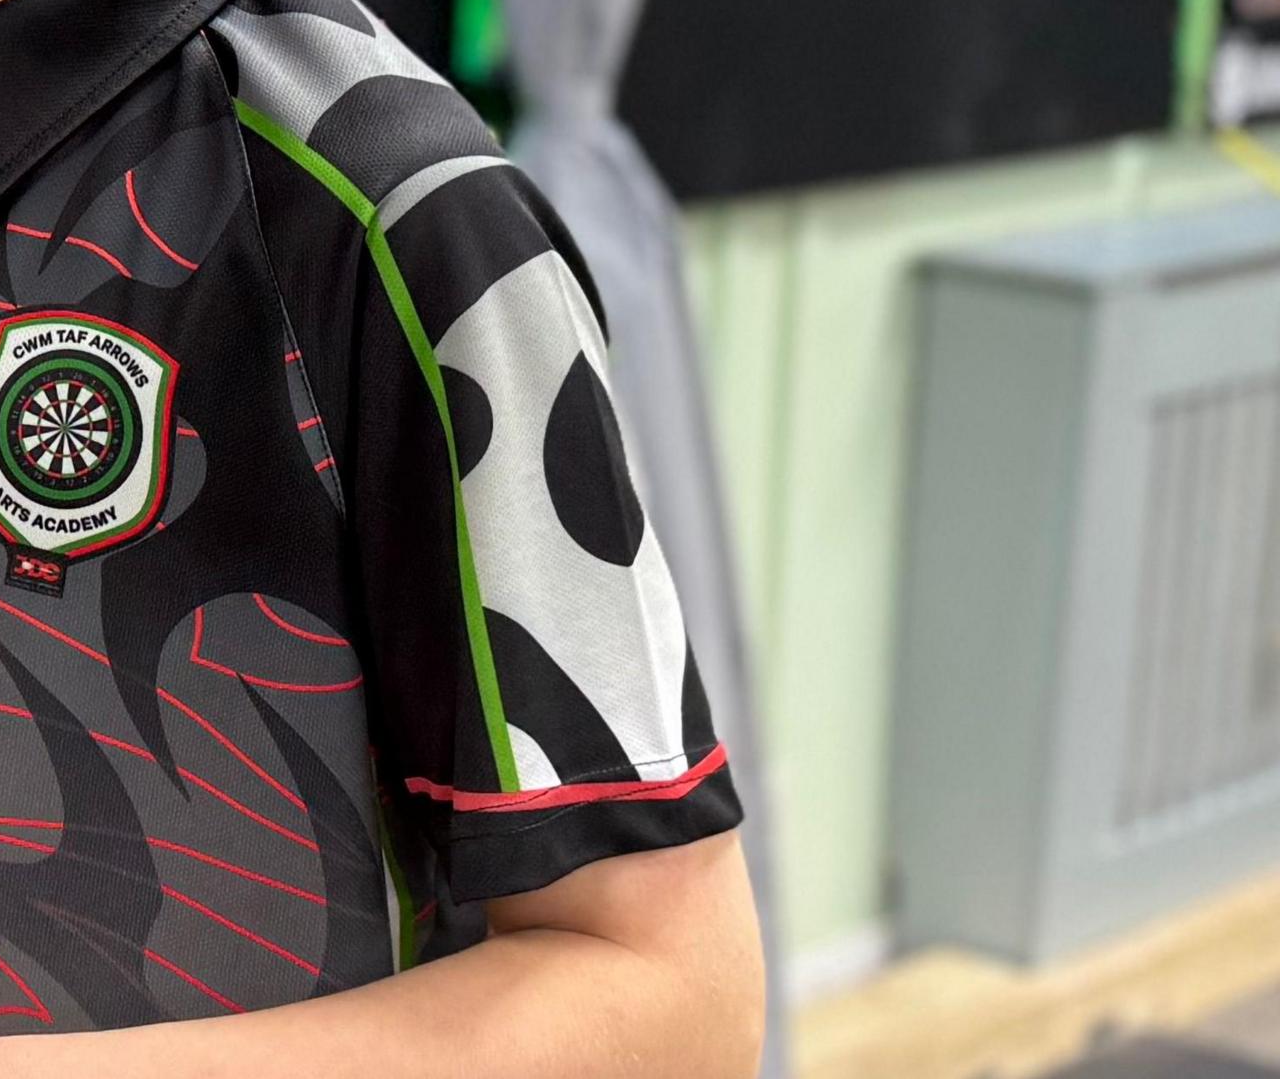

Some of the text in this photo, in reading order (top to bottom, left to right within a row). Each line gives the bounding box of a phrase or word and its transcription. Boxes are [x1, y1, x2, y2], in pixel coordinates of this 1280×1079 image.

[13, 332, 53, 360] CWM
[56, 329, 89, 344] TAF
[89, 334, 149, 389] ARROWS
[31, 506, 118, 533] ACADEMY
